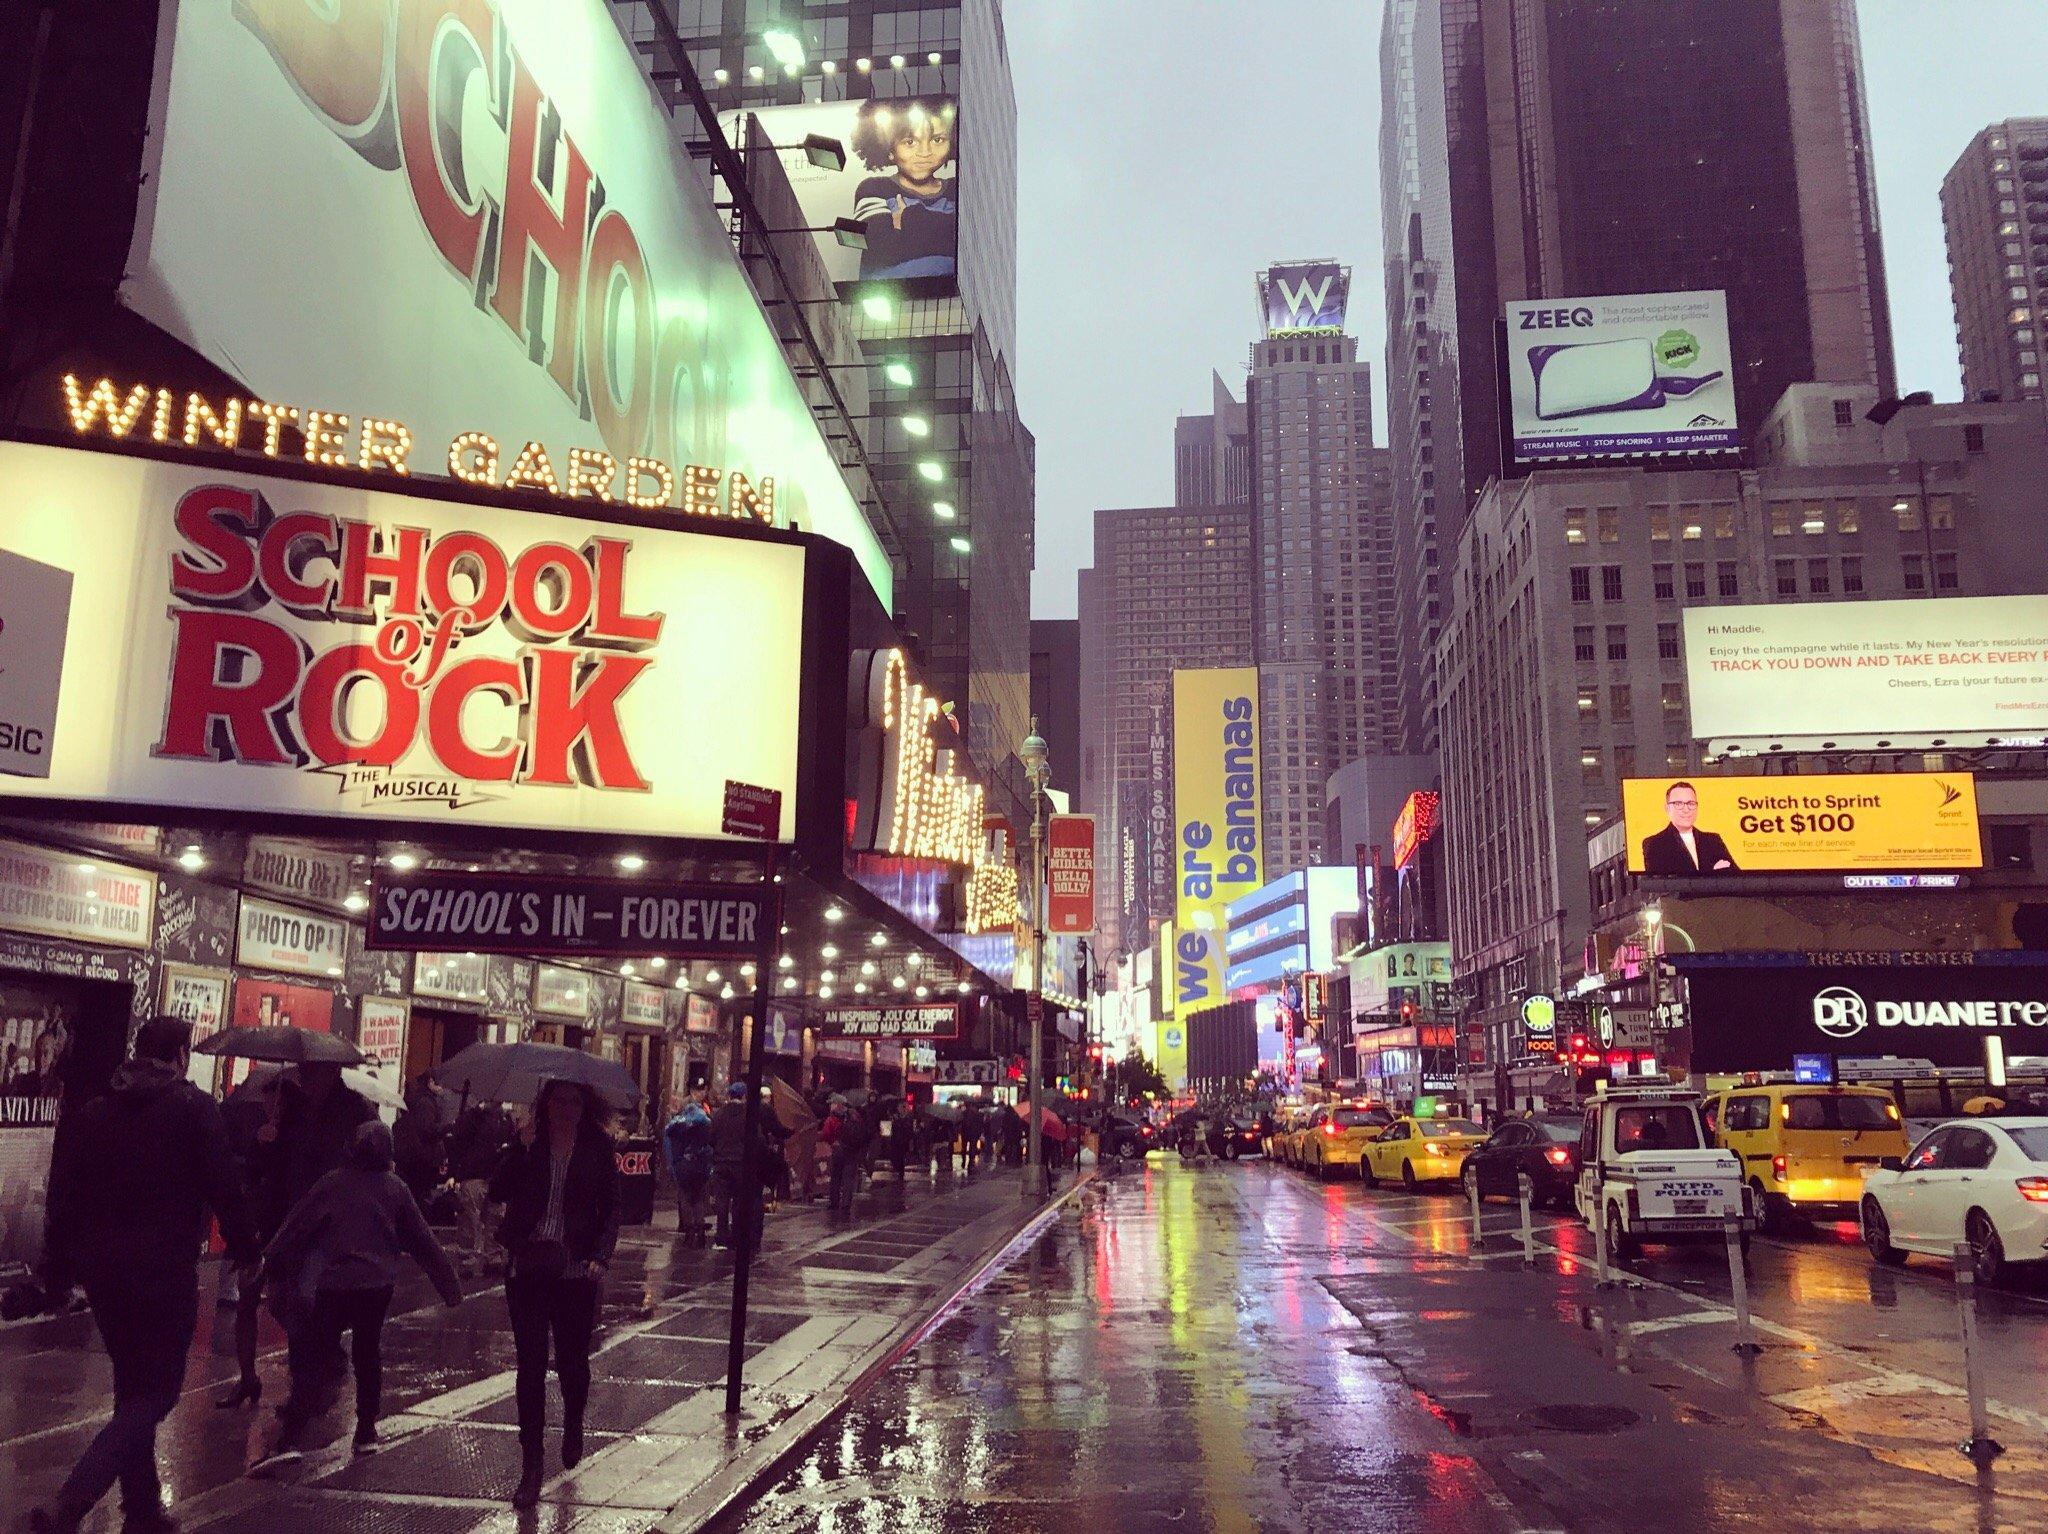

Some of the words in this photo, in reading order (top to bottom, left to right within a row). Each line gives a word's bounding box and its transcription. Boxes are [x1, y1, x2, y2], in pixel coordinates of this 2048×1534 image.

[1277, 276, 1333, 316] W
[1621, 306, 1644, 314] most
[1646, 303, 1710, 314] sophisticated
[1519, 307, 1594, 330] ZEEQ
[1602, 316, 1620, 324] and
[1622, 313, 1679, 323] comfortable
[1665, 344, 1693, 359] KICK
[1523, 442, 1554, 450] STREAM
[1556, 440, 1581, 448] MUSIC
[1594, 438, 1615, 446] STOP
[1616, 437, 1653, 445] SNORING
[1666, 435, 1690, 444] SLEEP
[1691, 433, 1729, 442] SMARTER
[64, 373, 412, 476] WINTER
[448, 431, 775, 527] GARDEN
[168, 483, 666, 652] SCHOOL
[1708, 625, 1719, 635] Hi
[1722, 624, 1765, 635] Maddie,
[373, 607, 476, 688] of
[1709, 645, 1741, 660] Enjoy
[1742, 645, 1760, 655] the
[1763, 643, 1828, 656] champagne
[1830, 641, 1859, 652] while
[1862, 641, 1871, 651] it
[1873, 639, 1904, 651] lasts.
[1906, 640, 1925, 652] My
[1926, 638, 1952, 649] New
[1954, 637, 1990, 648] Year's
[1710, 659, 1763, 672] TRACK
[1766, 658, 1799, 670] YOU
[1803, 656, 1853, 669] DOWN
[1856, 655, 1890, 667] AND
[1894, 653, 1934, 666] TAKE
[1938, 652, 1982, 665] BACK
[1986, 651, 2038, 664] EVERY
[1888, 677, 1932, 689] Cheers,
[1934, 677, 1960, 687] Ezra
[1993, 674, 2028, 685] future
[148, 605, 660, 794] ROCK
[1151, 705, 1165, 780] TIMES
[351, 770, 380, 784] THE
[374, 781, 461, 798] MUSICAL
[727, 785, 739, 797] NO
[740, 789, 773, 805] STANDING
[1217, 696, 1257, 883] bananas
[727, 798, 756, 813] Anytime
[1738, 796, 1799, 810] Switch
[1802, 797, 1821, 809] to
[1825, 794, 1881, 811] Sprint
[1938, 809, 1963, 820] Sprint
[1740, 816, 1785, 834] Get
[1790, 812, 1855, 835] $100
[1151, 789, 1167, 884] SQUARE
[1742, 840, 1755, 848] For
[1756, 839, 1778, 848] each
[1799, 839, 1813, 847] line
[1815, 839, 1824, 847] of
[1826, 839, 1856, 847] service
[1053, 847, 1091, 859] BETTE
[1183, 820, 1213, 900] are
[1050, 859, 1093, 869] MIDLER
[1053, 881, 1091, 894] DOLLY!
[1847, 877, 1912, 887] OUTFRONT
[1921, 877, 1955, 886] PRIME
[92, 874, 142, 908] VOLTAGE
[56, 898, 100, 929] GUITAR
[102, 904, 140, 935] AHEAD
[551, 894, 585, 937] IN
[245, 908, 300, 947] PHOTO
[304, 921, 326, 952] OP
[46, 948, 84, 964] GOING
[91, 954, 105, 967] ON
[1807, 951, 1892, 967] THEATER
[1900, 951, 1975, 966] CENTER
[85, 965, 119, 982] RECORD
[1177, 932, 1208, 1003] we
[172, 979, 189, 1000] WE
[446, 972, 480, 993] ROCK
[169, 999, 199, 1022] NEED
[825, 1011, 838, 1022] AN
[839, 1010, 882, 1022] INSPIRING
[883, 1010, 903, 1021] JOLT
[905, 1010, 917, 1020] OF
[1629, 1013, 1648, 1022] LEFT
[1814, 996, 1869, 1027] DR
[370, 1015, 400, 1027] WANNA
[842, 1023, 859, 1034] JOY
[860, 1021, 879, 1033] AND
[881, 1021, 900, 1033] MAD
[901, 1020, 935, 1033] SKILLZ!
[1629, 1024, 1649, 1032] TURN
[1528, 1041, 1556, 1050] FOOD
[1630, 1034, 1649, 1043] LANE
[380, 1046, 401, 1058] NITE
[1654, 1189, 1724, 1197] POLICE
[1662, 1182, 1715, 1190] NYPD
